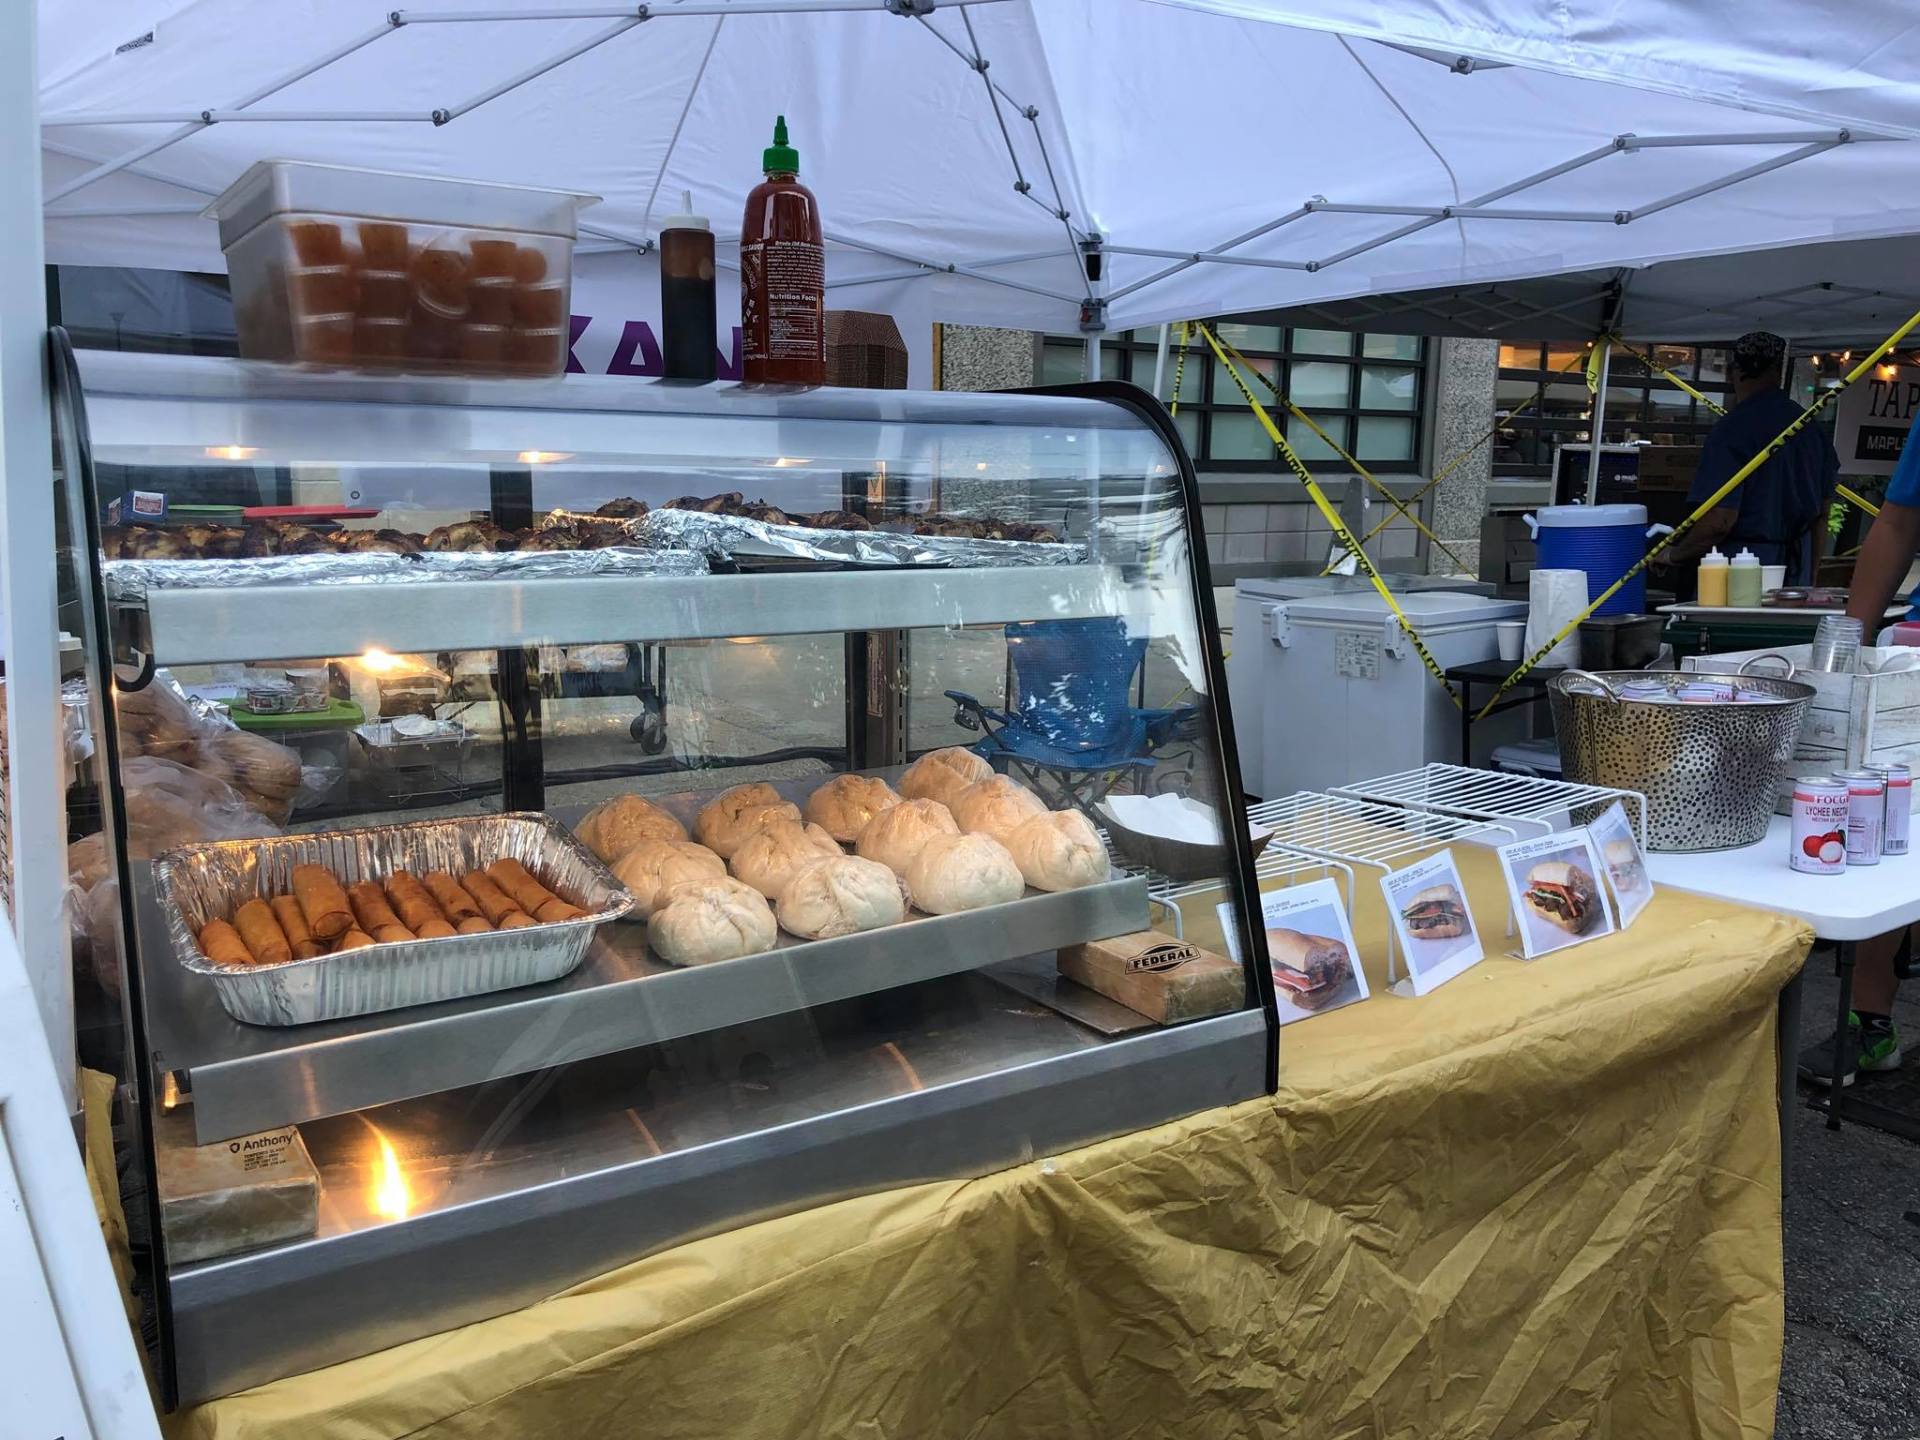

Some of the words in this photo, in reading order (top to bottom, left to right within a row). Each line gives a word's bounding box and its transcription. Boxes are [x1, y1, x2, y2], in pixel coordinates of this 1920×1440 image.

[769, 293, 800, 301] Nutrition
[801, 294, 816, 302] Facts
[1274, 440, 1312, 487] CAUTION
[1335, 528, 1376, 579] CAUTION
[1408, 629, 1459, 699] CAUTION
[1805, 806, 1830, 816] LYCHEE
[1132, 948, 1193, 969] FEDERAL
[243, 1134, 293, 1151] Anthony
